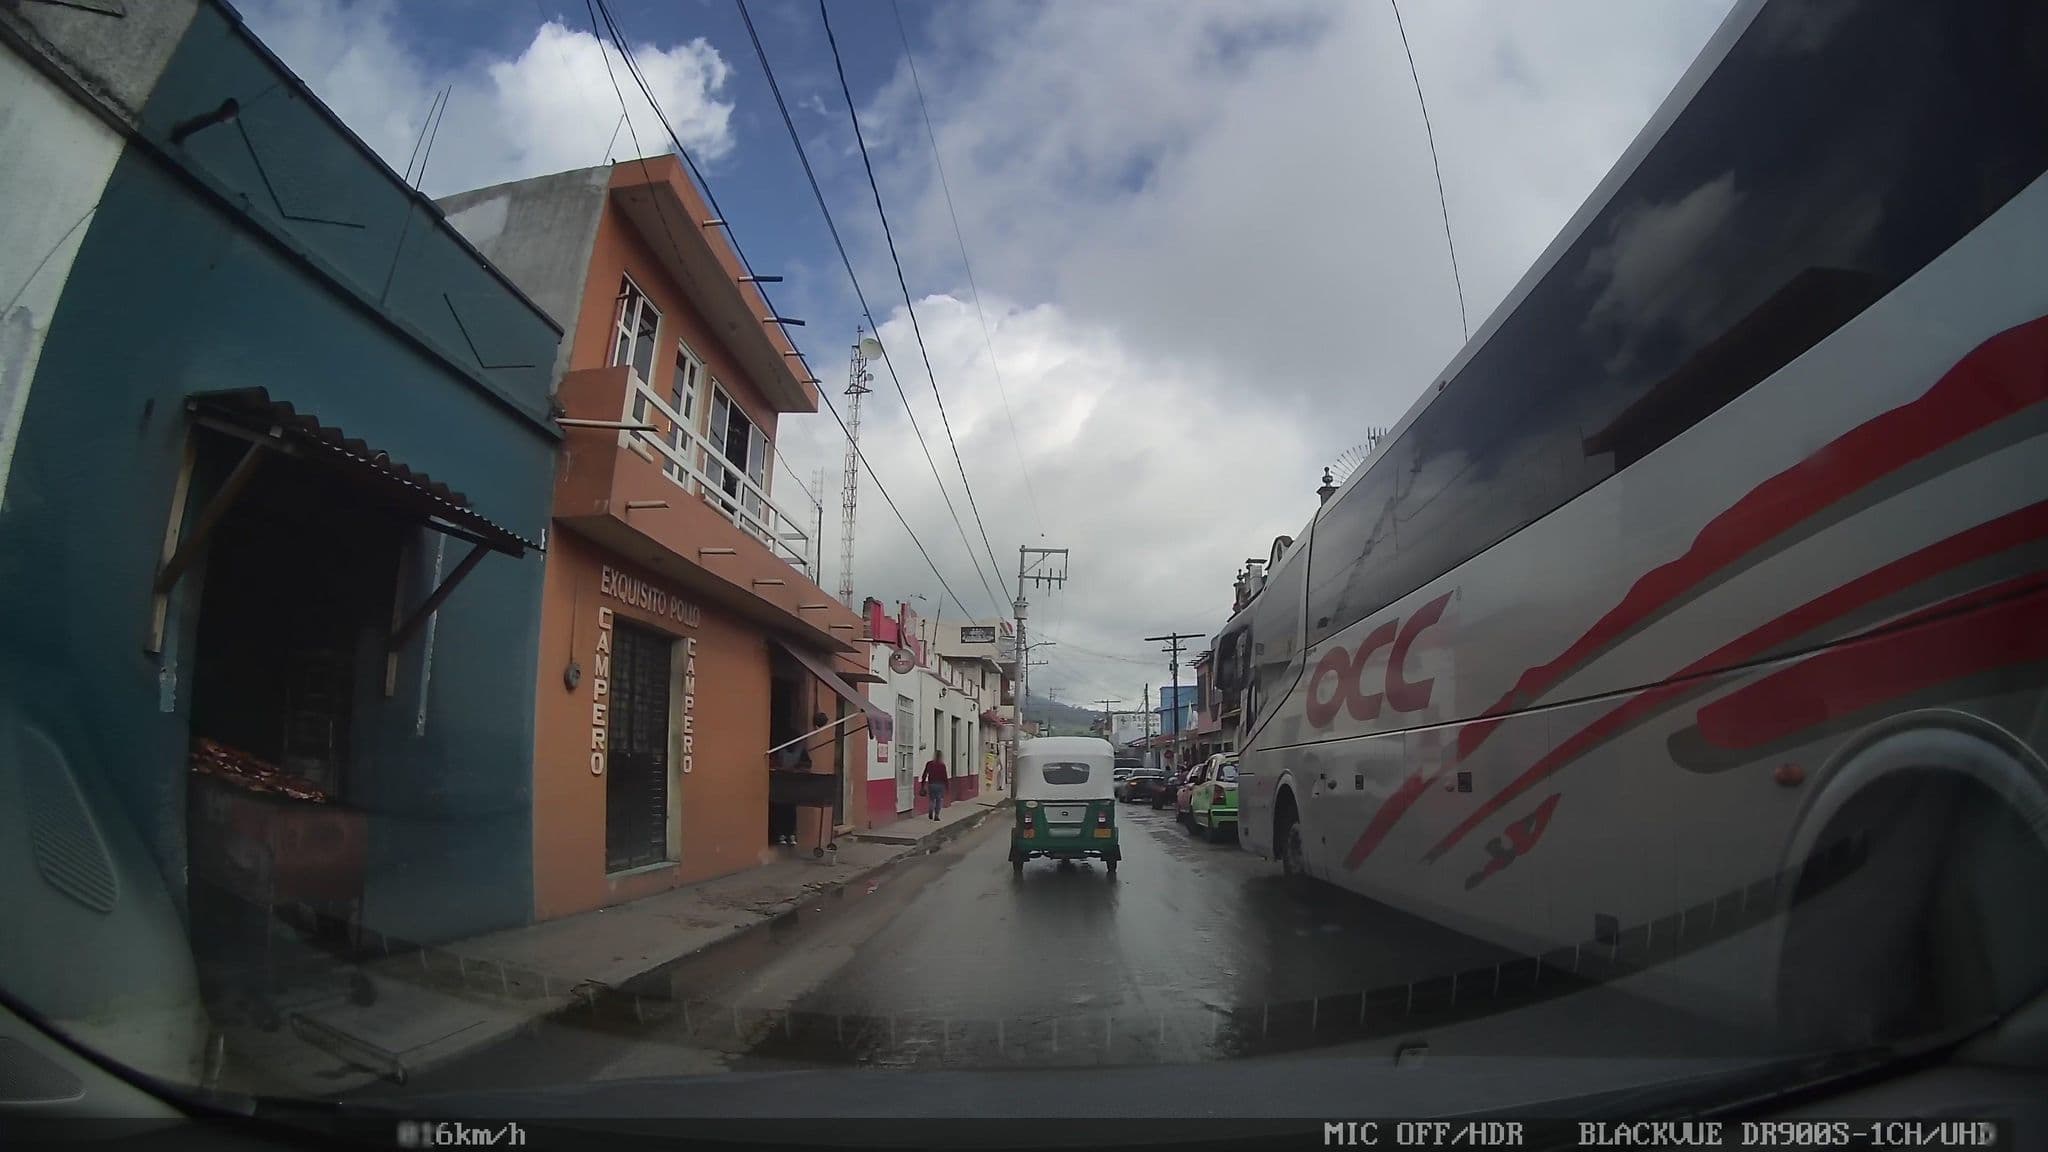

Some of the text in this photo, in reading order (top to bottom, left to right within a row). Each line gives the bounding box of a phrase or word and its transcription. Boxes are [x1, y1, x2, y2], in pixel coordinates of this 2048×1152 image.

[601, 565, 700, 628] EXQUISITO POLLO
[1306, 590, 1454, 728] OCC
[591, 607, 612, 775] CAMPERO
[684, 638, 697, 773] CAMPERO
